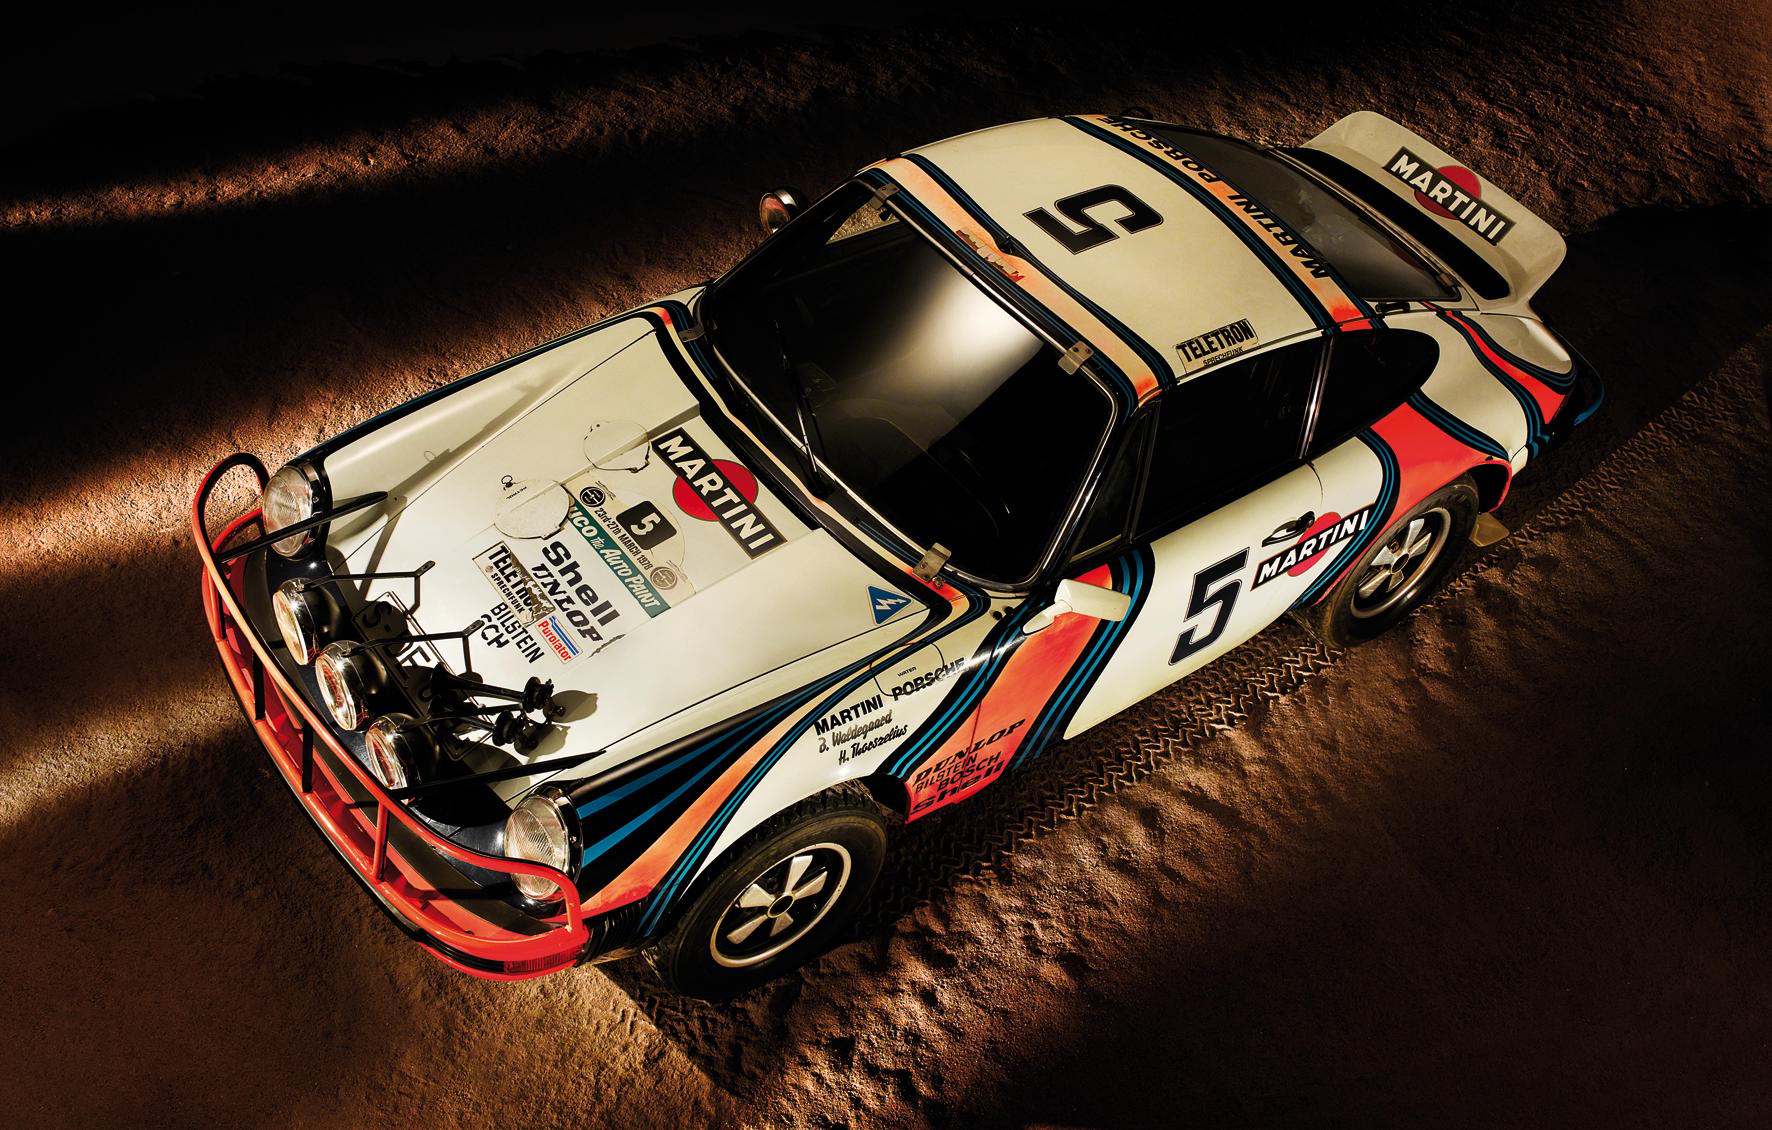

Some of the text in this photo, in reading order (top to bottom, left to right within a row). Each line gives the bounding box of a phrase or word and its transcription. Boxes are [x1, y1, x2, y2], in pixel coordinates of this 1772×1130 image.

[1022, 183, 1164, 255] 5
[1096, 115, 1330, 279] MARTINI PORSCHE
[1390, 153, 1506, 240] MARTINI
[1175, 319, 1255, 363] TELETRON
[1202, 346, 1244, 366] SPRECHFUNK
[630, 512, 661, 536] 5
[658, 435, 775, 550] MARTINI
[594, 507, 621, 536] 23rd-27th
[618, 532, 642, 557] MARCH
[637, 554, 654, 571] 1978
[1257, 509, 1370, 585] MARTINI
[490, 572, 526, 614] SPRECHFUNK
[542, 540, 621, 627] Shell
[590, 536, 605, 550] the
[599, 548, 633, 577] AUTO
[624, 573, 660, 608] PAINT
[490, 601, 545, 664] BILSTEIN
[1168, 546, 1251, 667] 5
[537, 620, 572, 662] Purolator
[897, 666, 917, 678] WATER
[813, 657, 966, 736] MARTINI PORSCHE
[838, 749, 849, 766] H.
[912, 718, 1026, 787] DUNLOP
[915, 753, 978, 794] BILSTEIN
[937, 751, 1002, 792] BOSCH
[910, 760, 1005, 815] Shell
